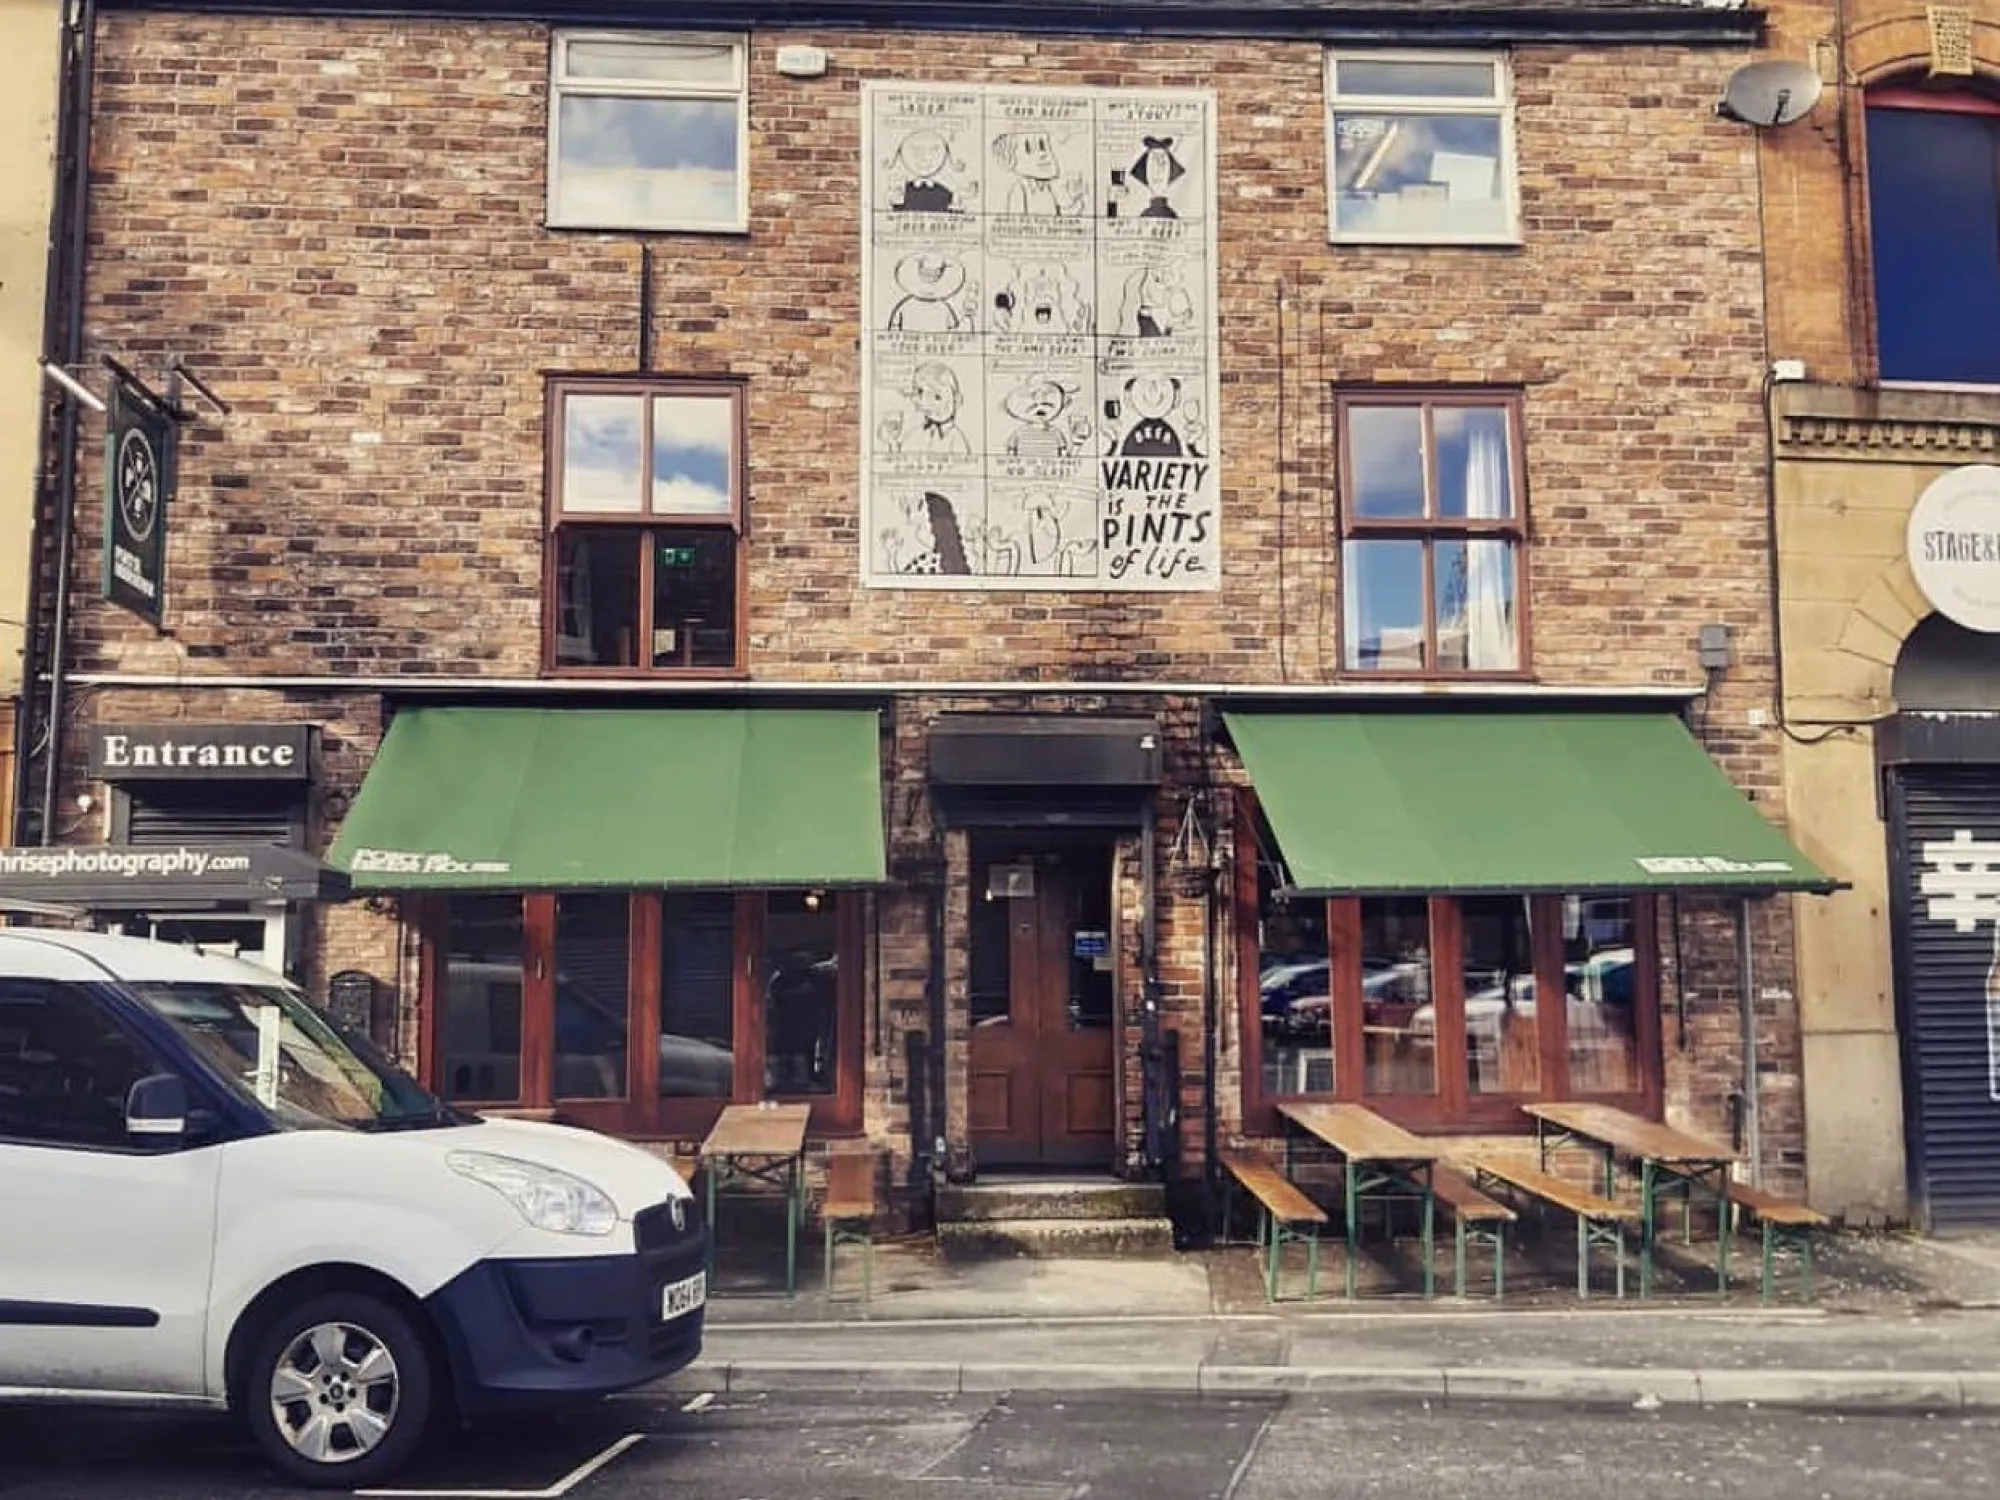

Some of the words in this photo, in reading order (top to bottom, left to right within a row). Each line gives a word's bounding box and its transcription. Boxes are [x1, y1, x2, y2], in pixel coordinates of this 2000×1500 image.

[1102, 460, 1209, 492] VARIETY
[1108, 493, 1124, 516] is
[1146, 493, 1188, 509] THE
[1103, 511, 1212, 549] PINTS
[1110, 548, 1141, 579] of
[1145, 546, 1206, 578] life
[103, 735, 294, 767] Entrance
